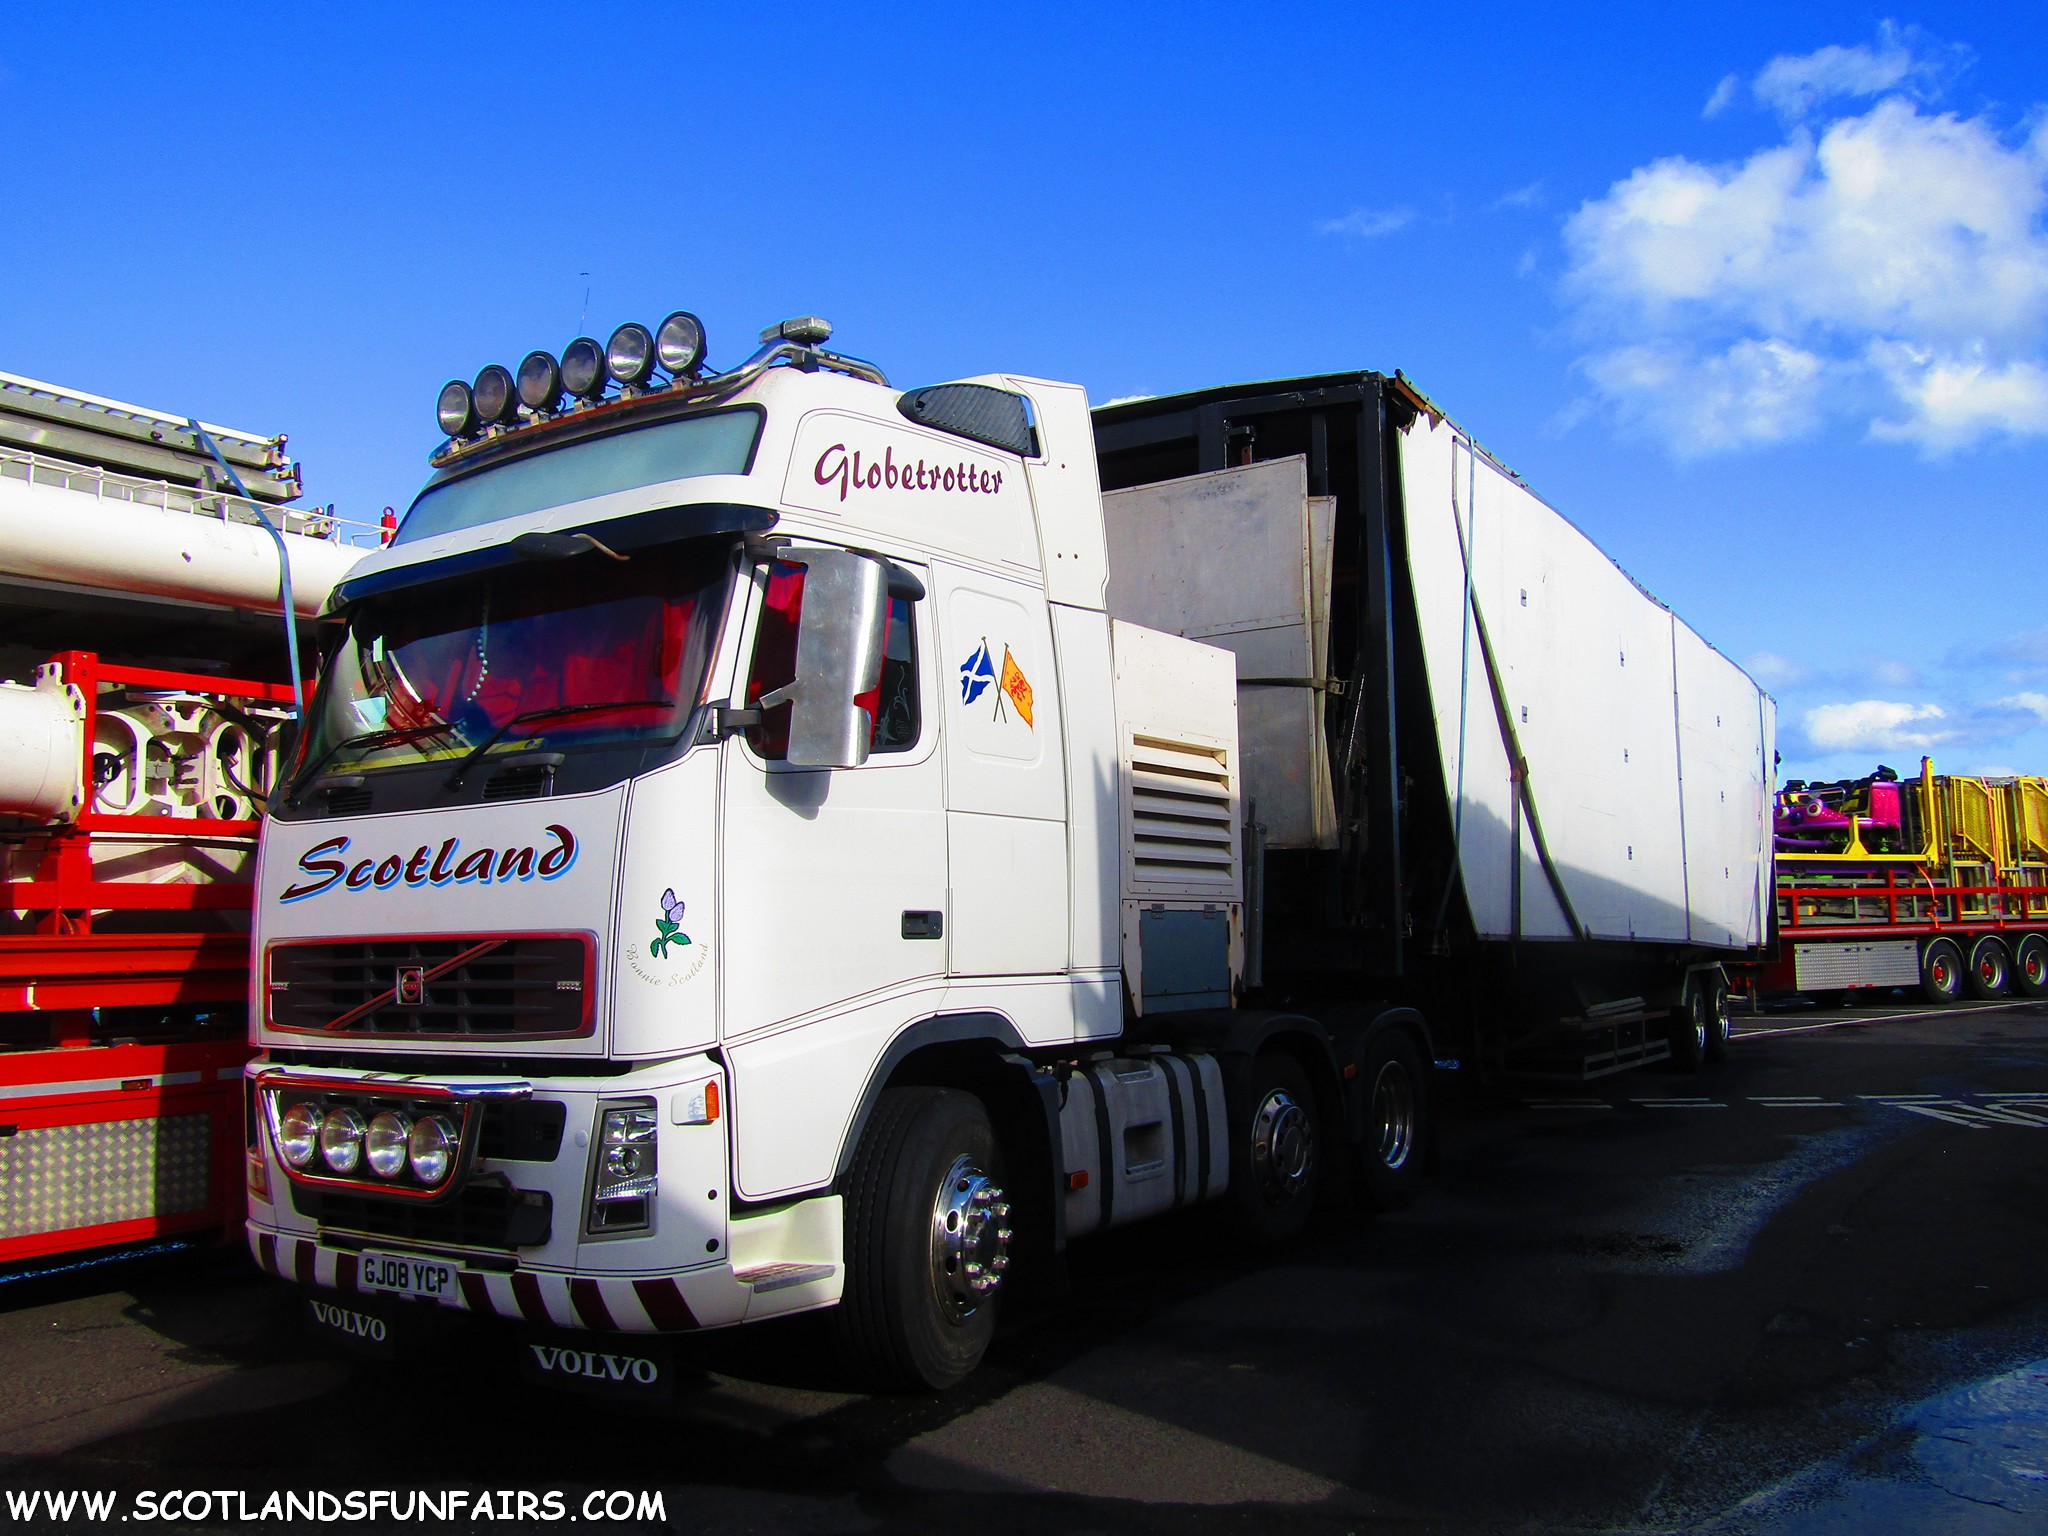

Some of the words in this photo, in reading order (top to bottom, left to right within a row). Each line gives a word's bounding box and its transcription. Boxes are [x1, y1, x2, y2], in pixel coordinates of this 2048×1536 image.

[814, 444, 1003, 502] Globetrotter
[279, 823, 578, 904] Scotland
[625, 943, 662, 986] Bonnie
[668, 943, 709, 987] Scotland
[365, 1258, 409, 1289] GJ08
[414, 1263, 449, 1293] YCP
[310, 1300, 387, 1342] VOLVO
[530, 1344, 659, 1385] VOLVO
